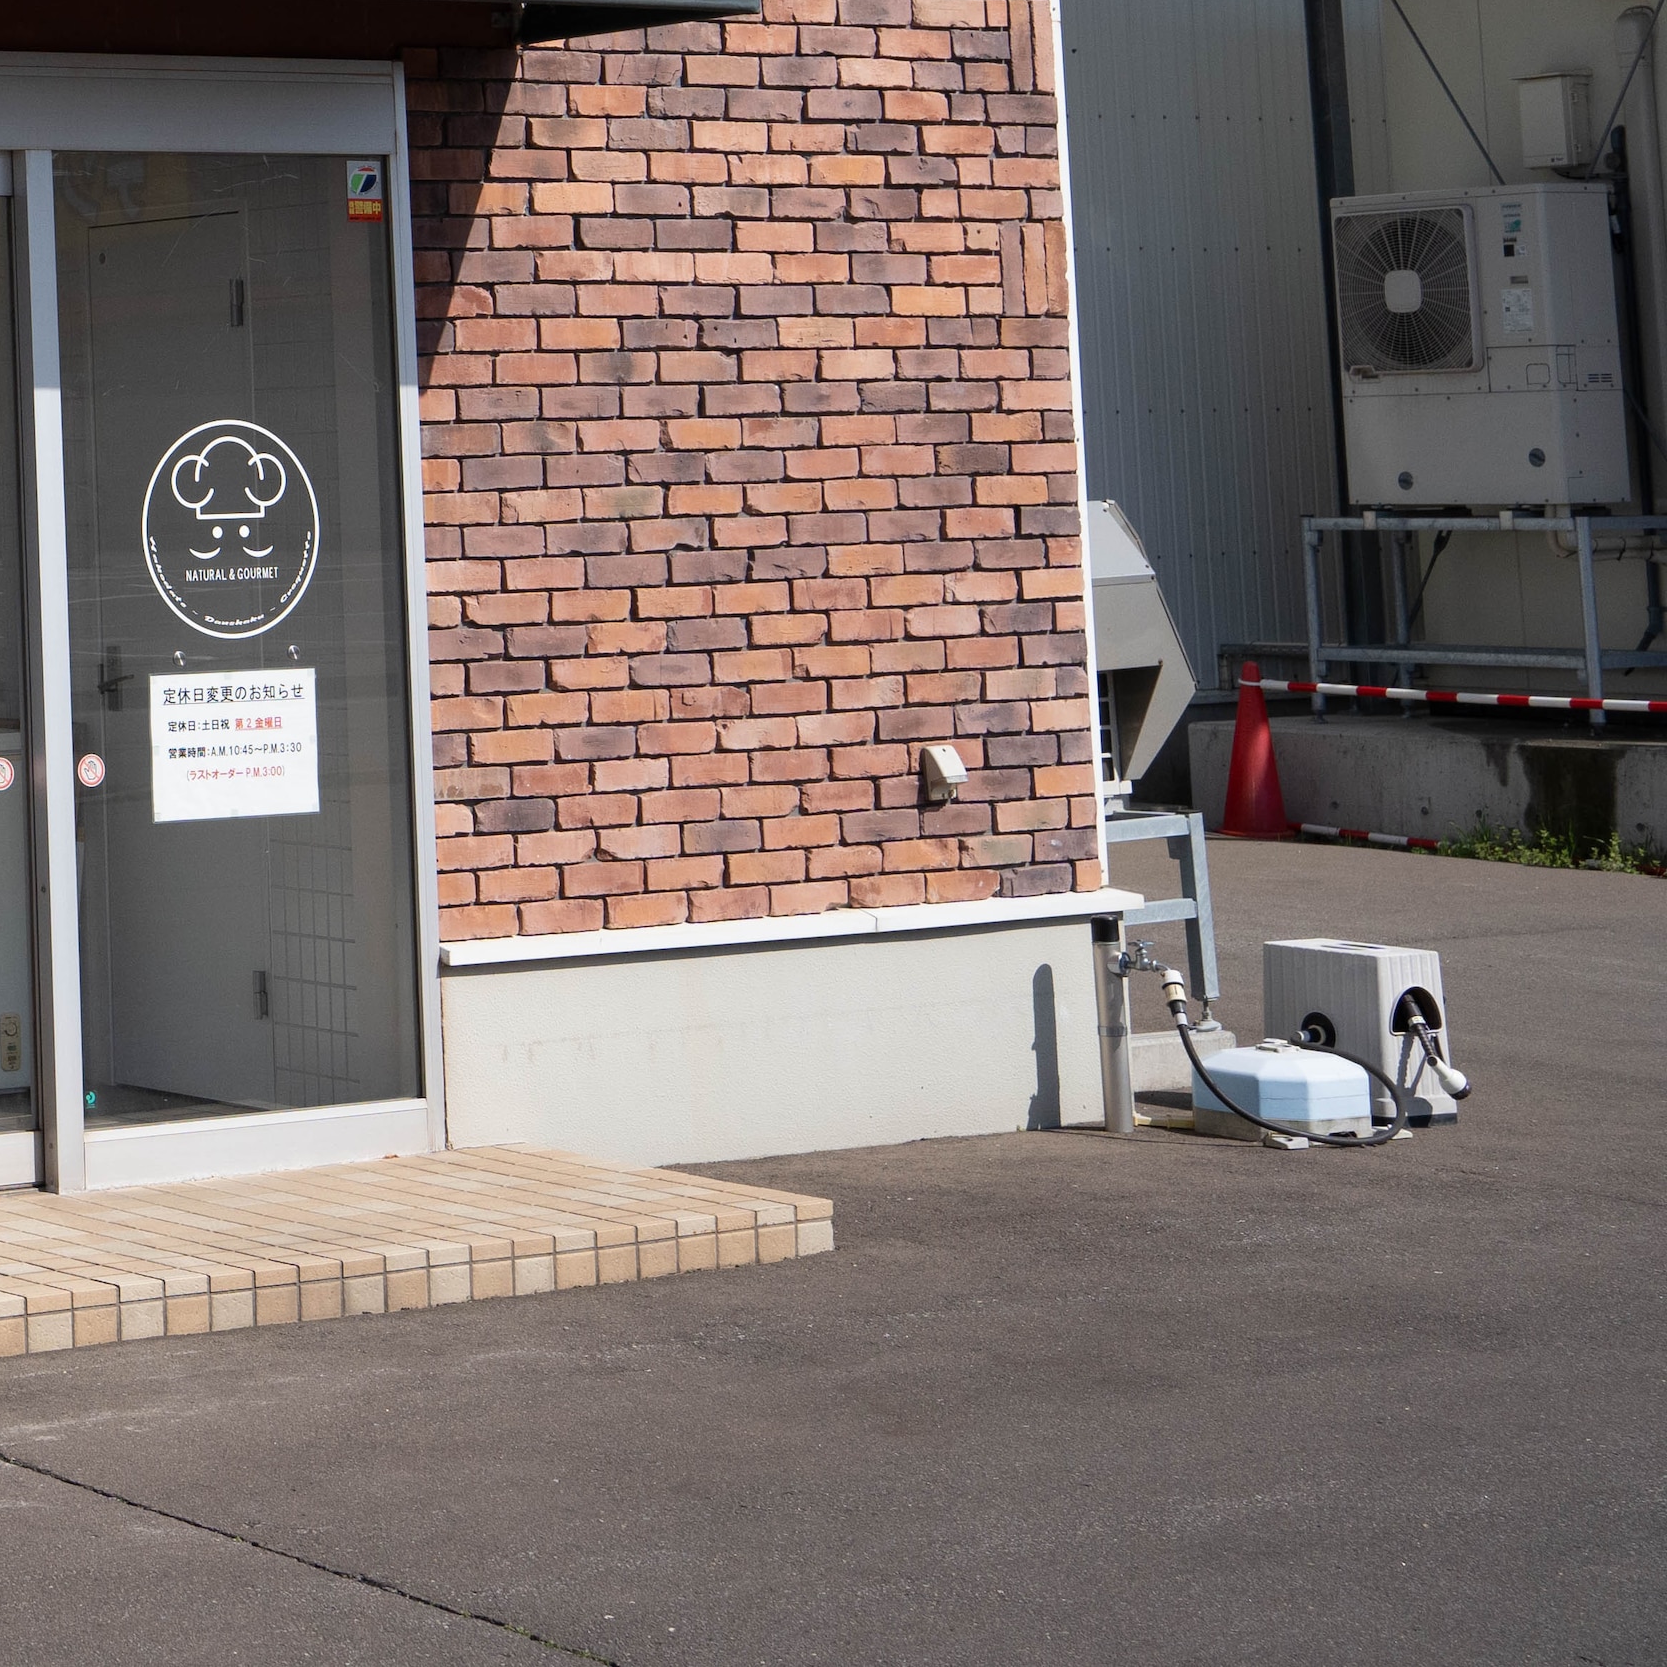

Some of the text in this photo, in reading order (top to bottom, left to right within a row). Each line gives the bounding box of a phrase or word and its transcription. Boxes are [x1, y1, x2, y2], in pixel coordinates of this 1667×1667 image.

[185, 566, 279, 582] NATURAL & GOURMET
[163, 683, 304, 704] 定休日変更のお知らせ
